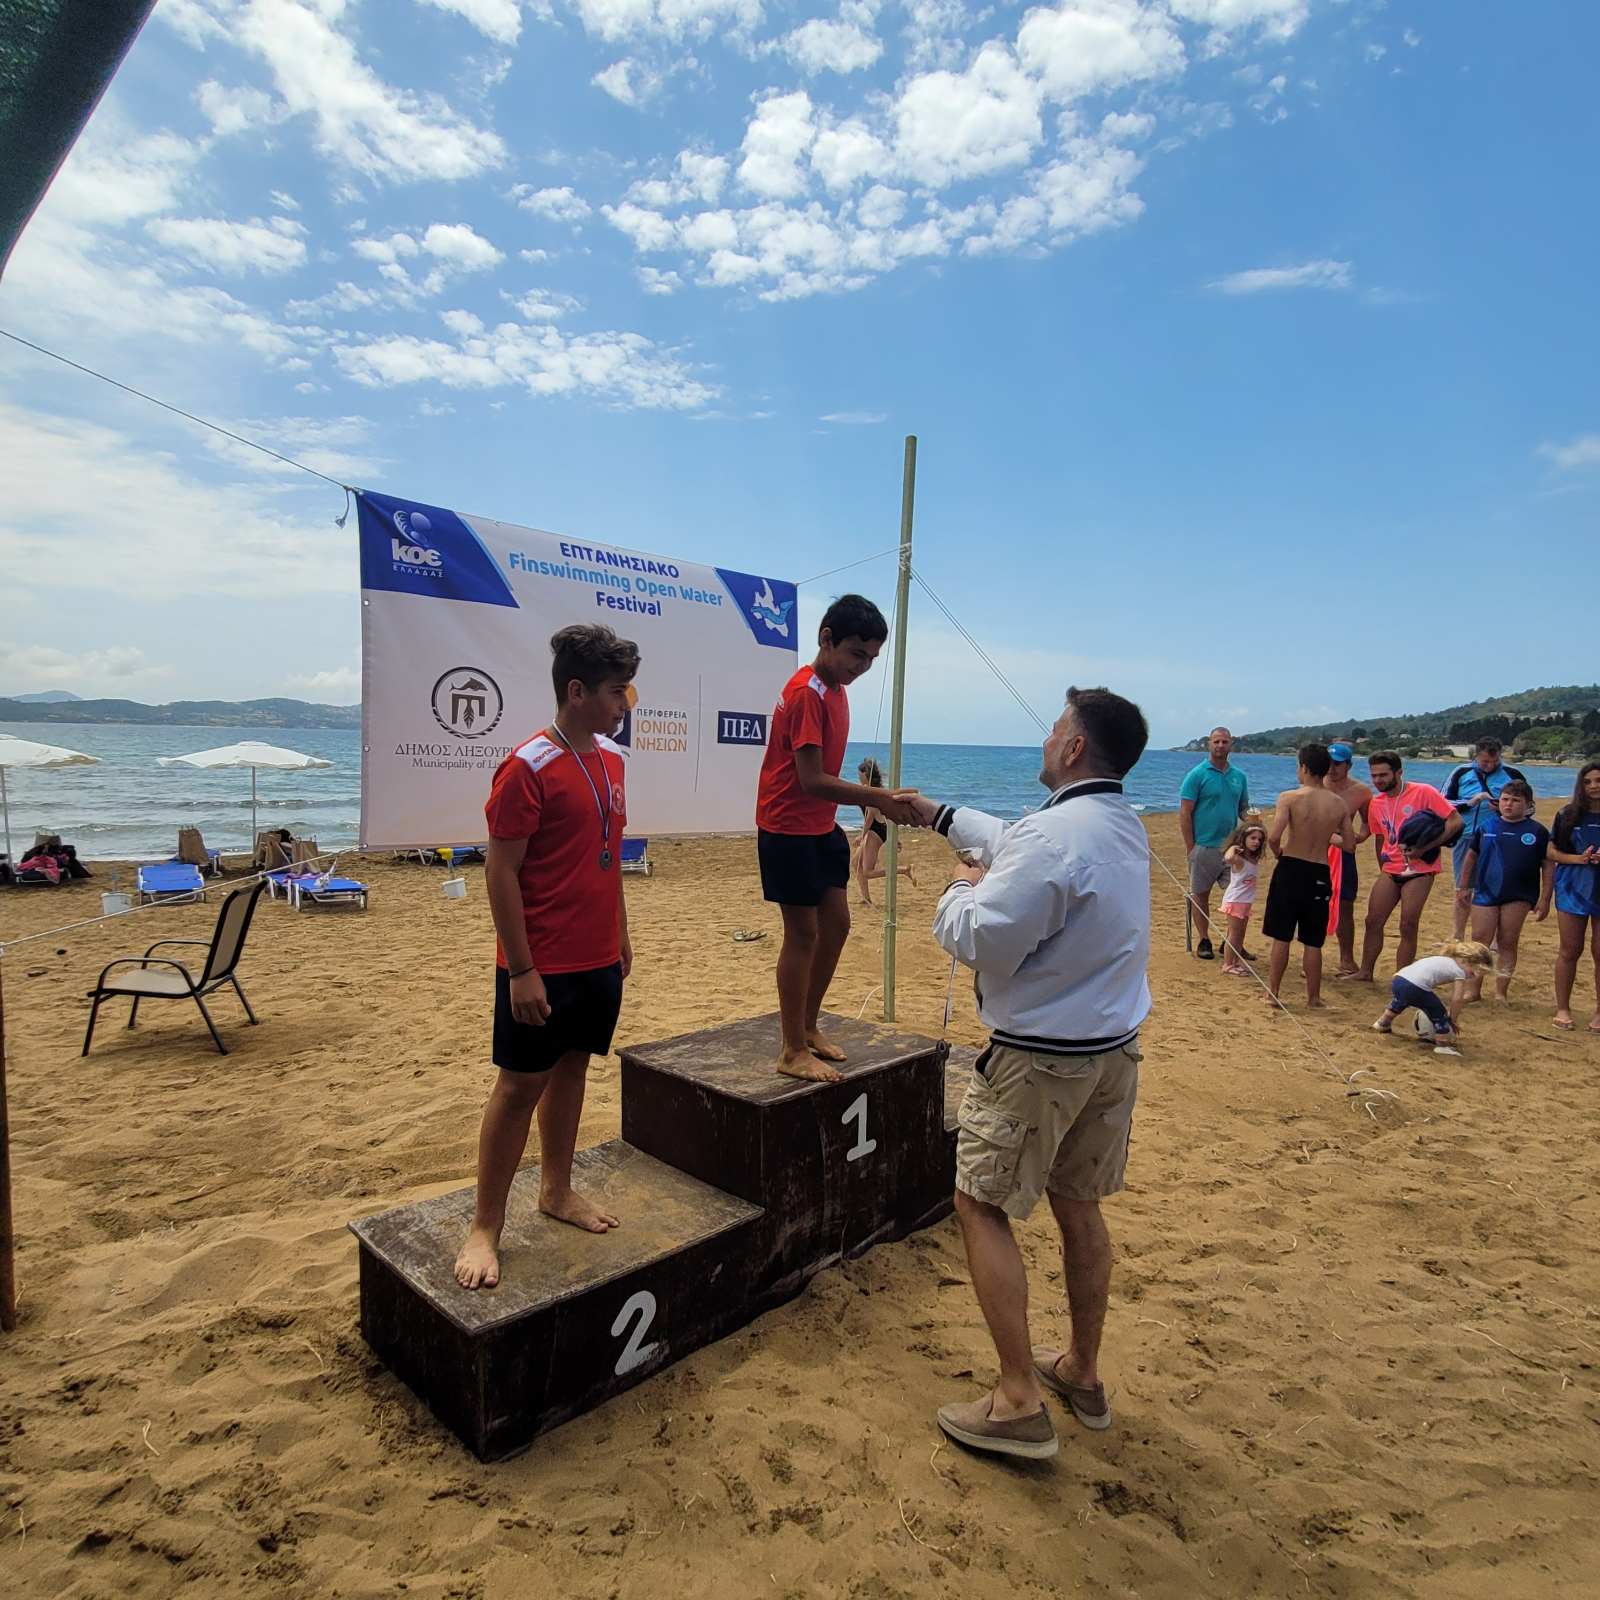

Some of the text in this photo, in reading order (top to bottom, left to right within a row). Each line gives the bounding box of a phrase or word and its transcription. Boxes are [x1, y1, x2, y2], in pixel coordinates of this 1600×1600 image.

[560, 542, 679, 578] ΕΠΤΑΝΗΣΙΑΚΟ
[509, 552, 723, 606] Finswimming Open Water
[596, 591, 662, 616] Festival
[636, 708, 687, 719] ΠΕΡΙΦΕΡΕΙΑ
[636, 720, 688, 735] ΙΟΝΙΩΝ
[722, 717, 762, 739] ΠΕΔ
[395, 743, 451, 756] ΔΗΜΟΣ
[636, 737, 688, 752] ΝΗΣΙΩΝ
[412, 758, 474, 770] Municipality
[476, 760, 487, 769] of
[841, 1092, 877, 1162] 1
[610, 1290, 660, 1376] 2
